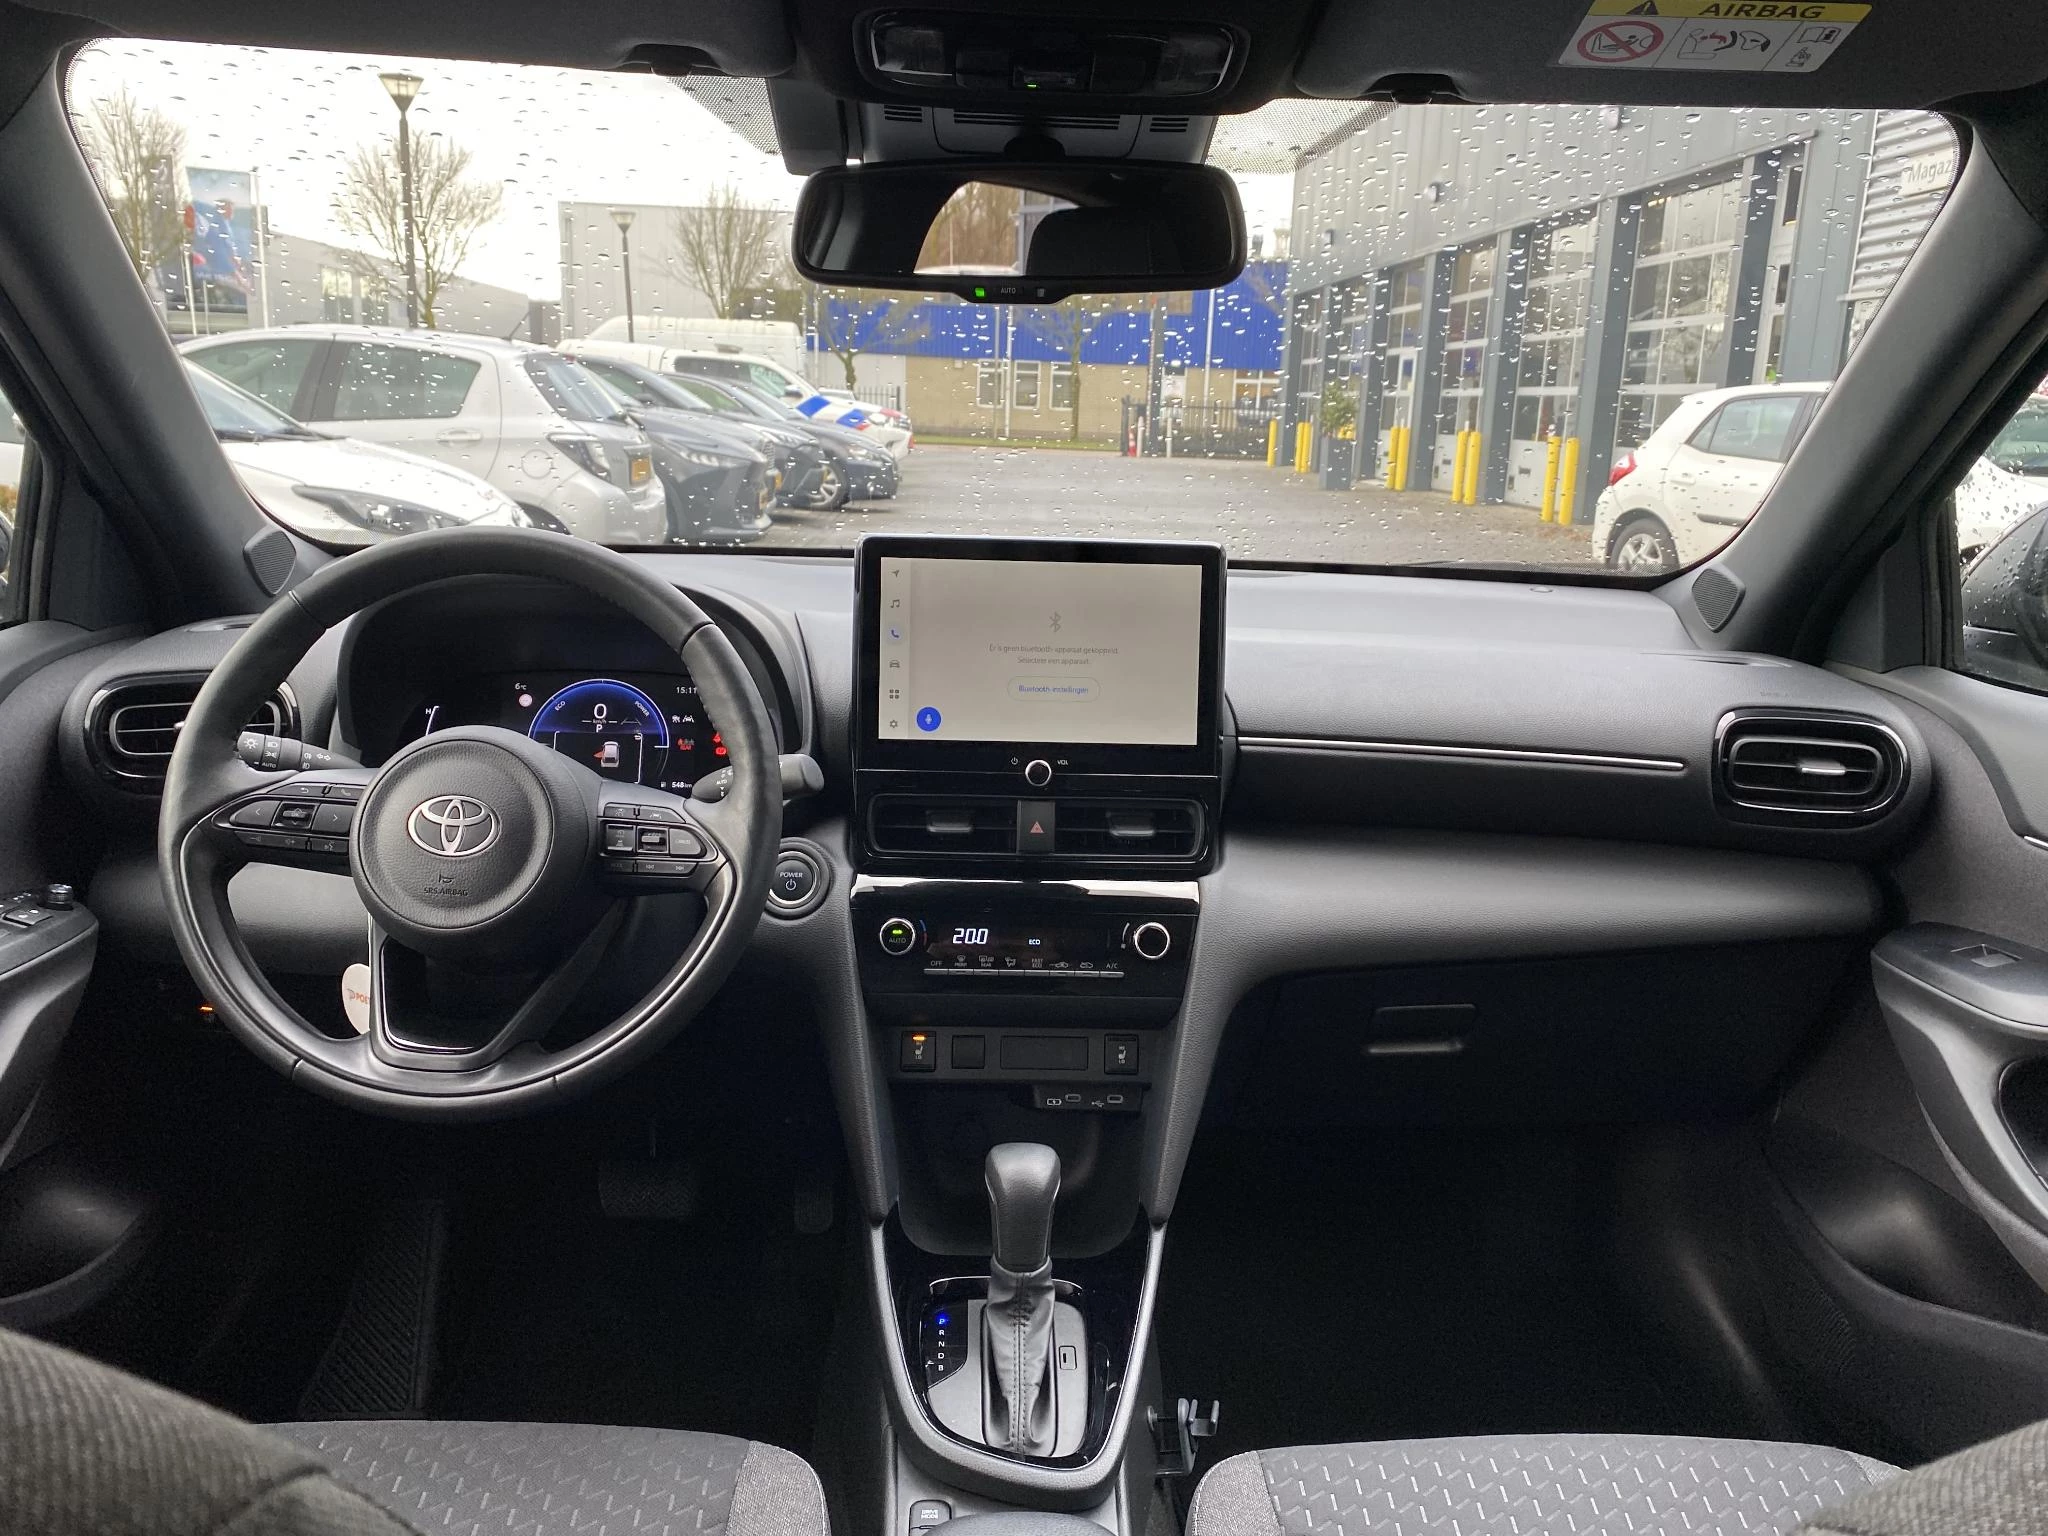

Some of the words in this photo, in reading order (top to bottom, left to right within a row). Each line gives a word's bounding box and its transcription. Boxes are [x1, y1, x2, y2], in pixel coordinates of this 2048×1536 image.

[1698, 3, 1826, 19] AIRBAG
[554, 700, 566, 711] ECO
[593, 703, 607, 719] 0
[634, 700, 650, 717] POWER
[595, 724, 603, 733] P
[424, 886, 438, 894] SRS
[440, 888, 468, 897] AIRBAG
